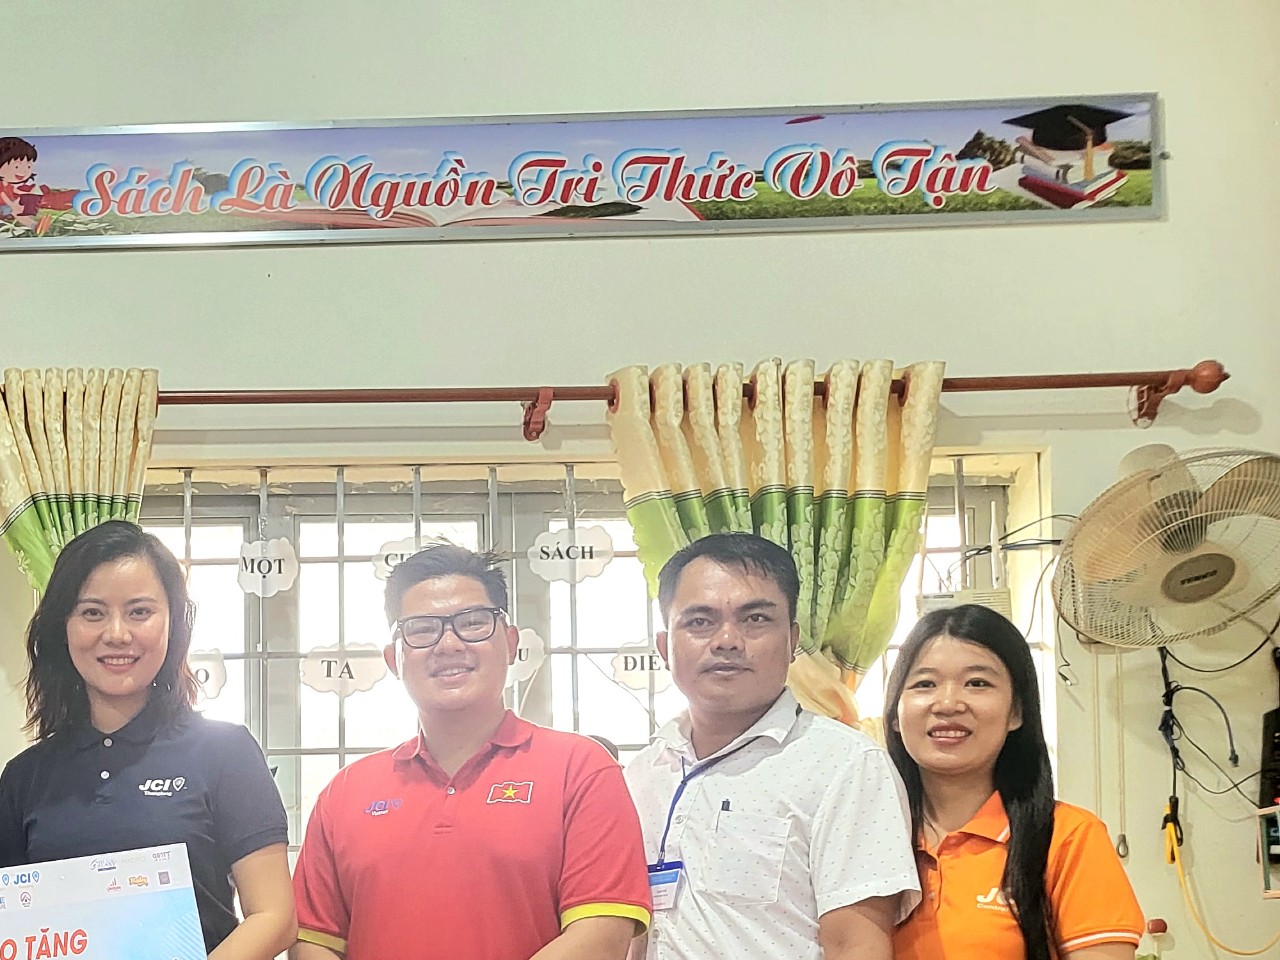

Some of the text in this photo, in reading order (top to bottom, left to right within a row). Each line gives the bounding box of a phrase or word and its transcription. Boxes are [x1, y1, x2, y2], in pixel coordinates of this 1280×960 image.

[78, 146, 997, 221] Sách Là Nguồn Tri Thức Vô Tận
[539, 541, 594, 560] SÁCH
[241, 556, 285, 579] MỘT
[320, 659, 355, 680] TA
[139, 779, 173, 791] JCI
[13, 873, 31, 885] JCI
